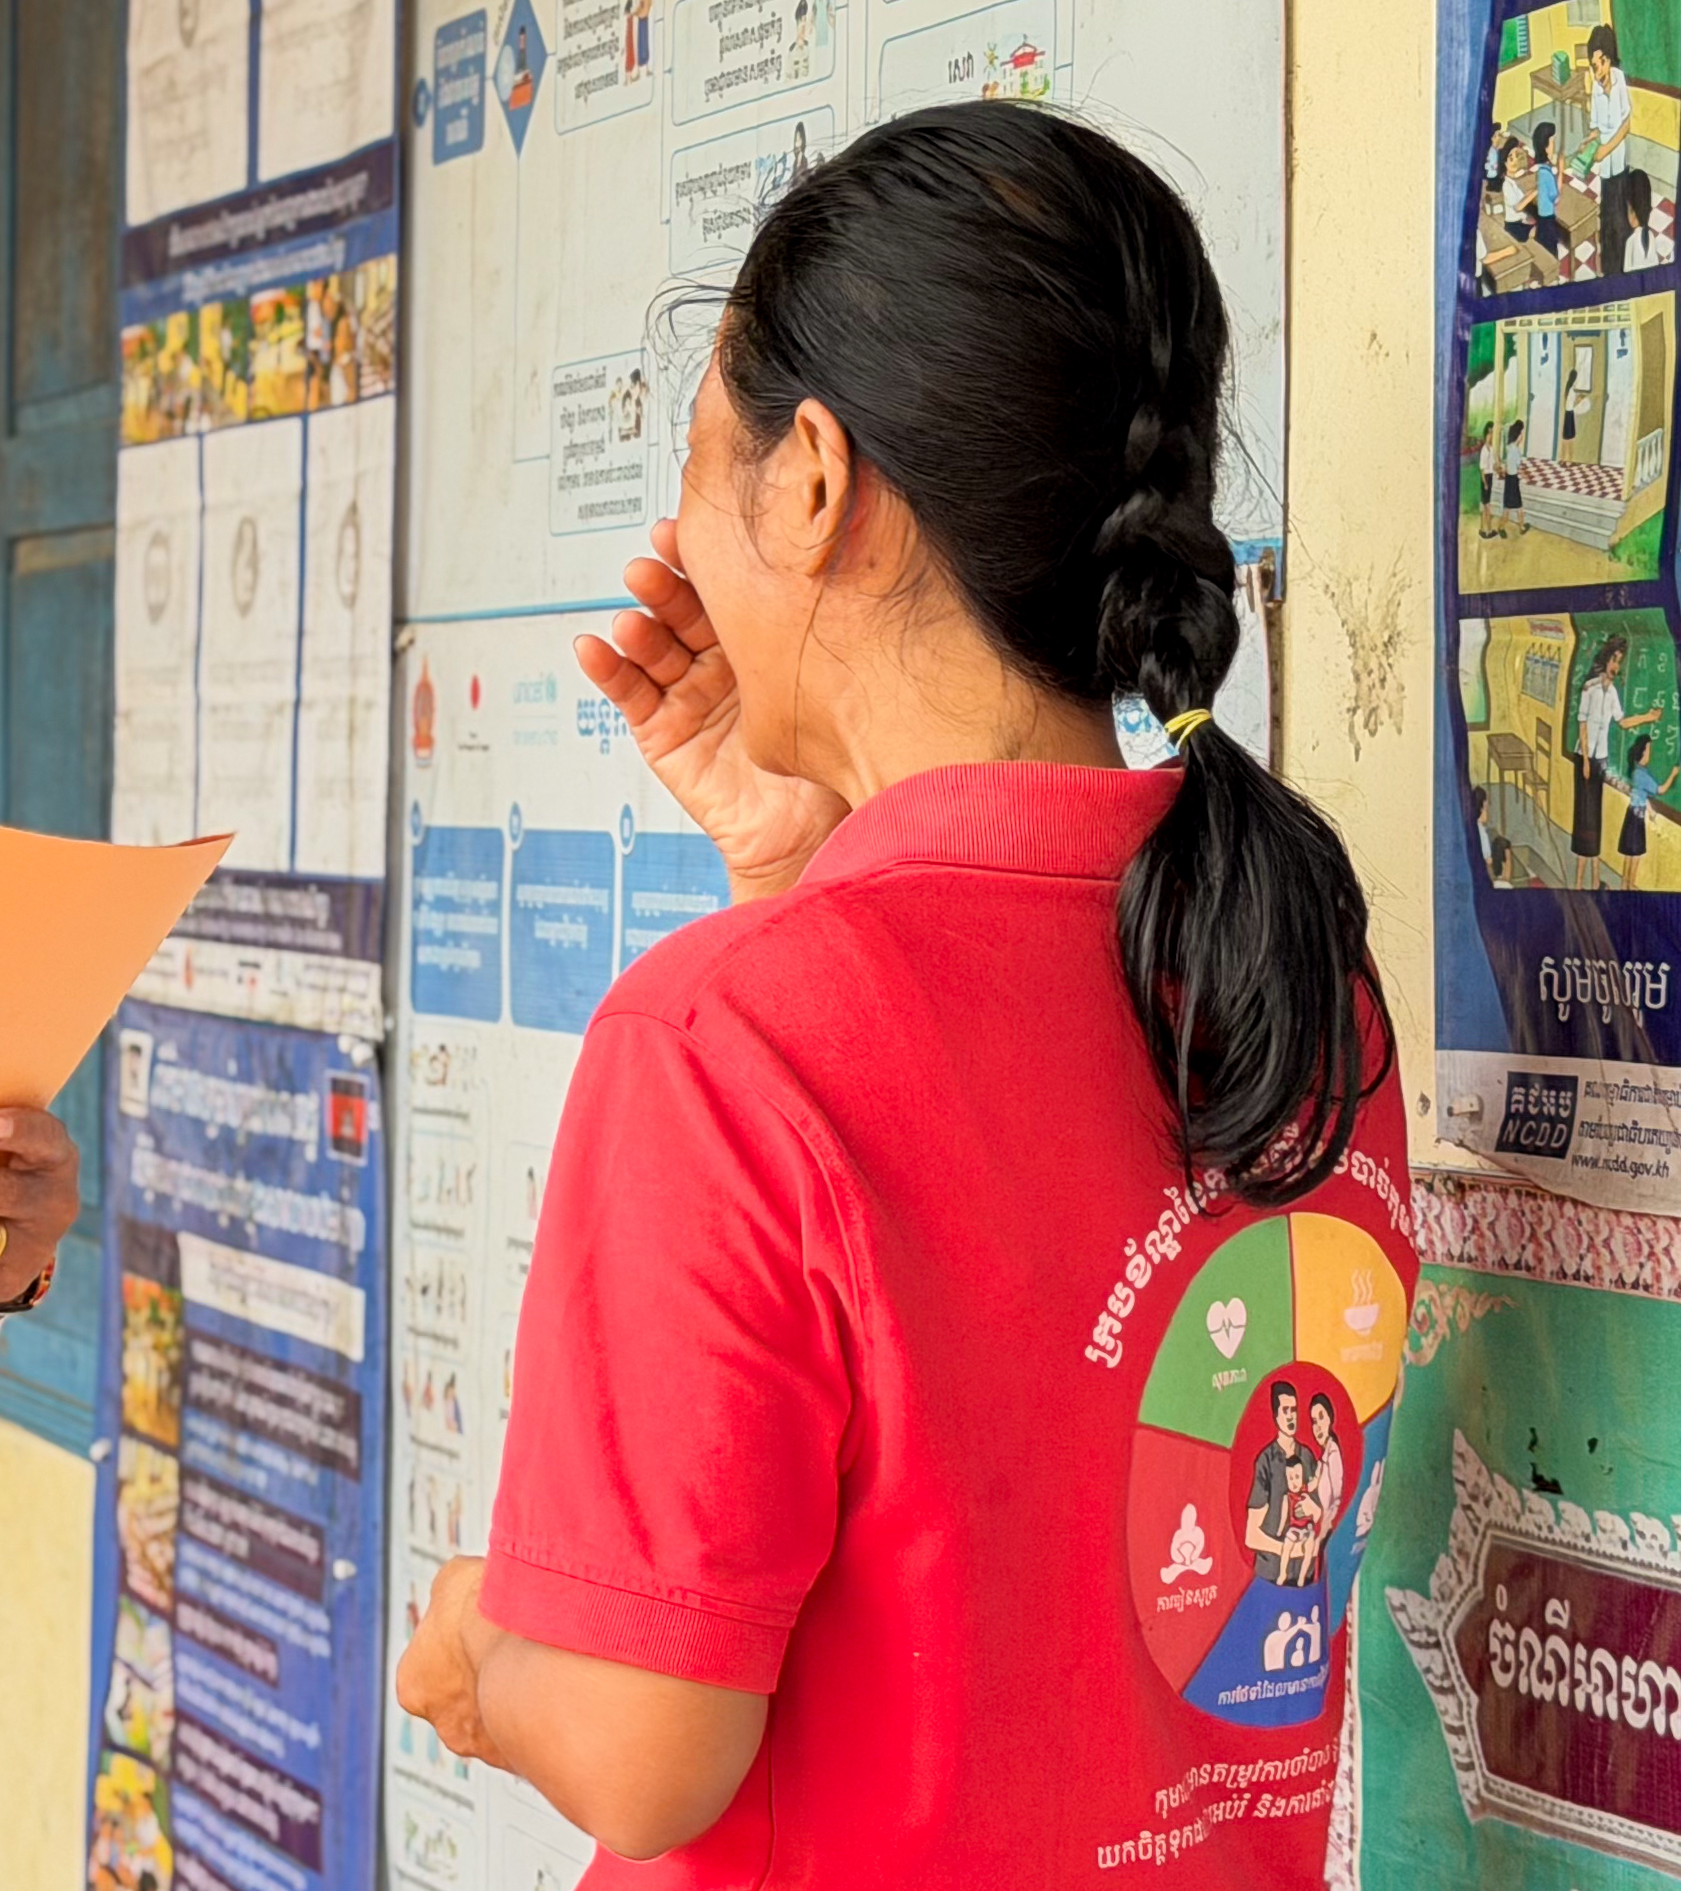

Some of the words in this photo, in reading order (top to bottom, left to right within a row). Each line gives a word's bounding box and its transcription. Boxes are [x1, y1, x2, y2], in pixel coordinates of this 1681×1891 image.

[1538, 955, 1671, 1025] សូមចូលរួម
[1502, 1120, 1568, 1149] NCDD
[1571, 1154, 1670, 1180] www.ncdd.gov.kh
